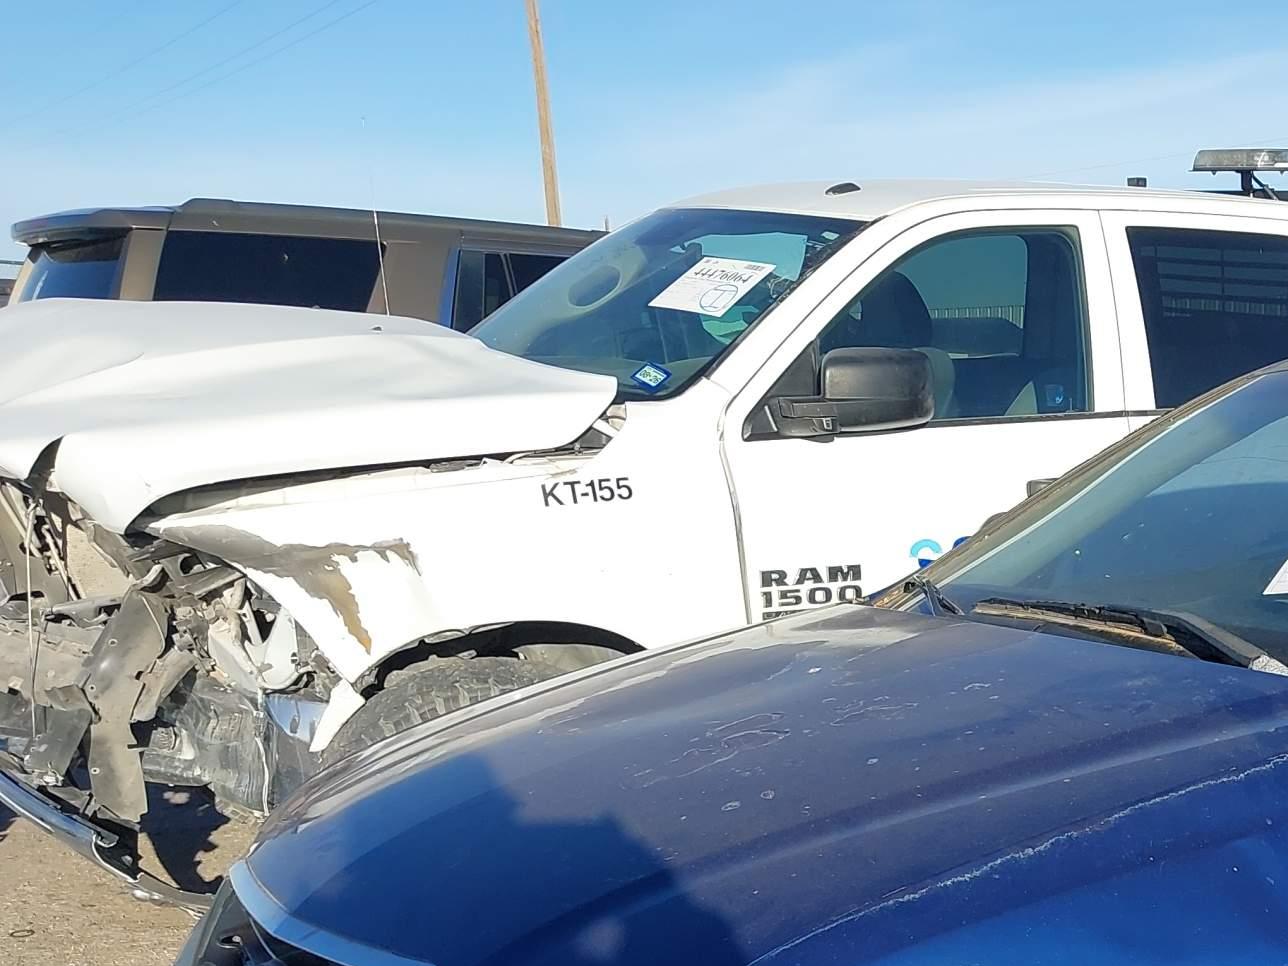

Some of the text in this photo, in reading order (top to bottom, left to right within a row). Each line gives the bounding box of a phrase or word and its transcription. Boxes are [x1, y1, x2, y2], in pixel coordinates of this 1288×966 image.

[694, 267, 754, 284] 44476064
[541, 477, 633, 507] KT-155
[760, 564, 862, 588] RAM
[760, 584, 862, 609] 1500
